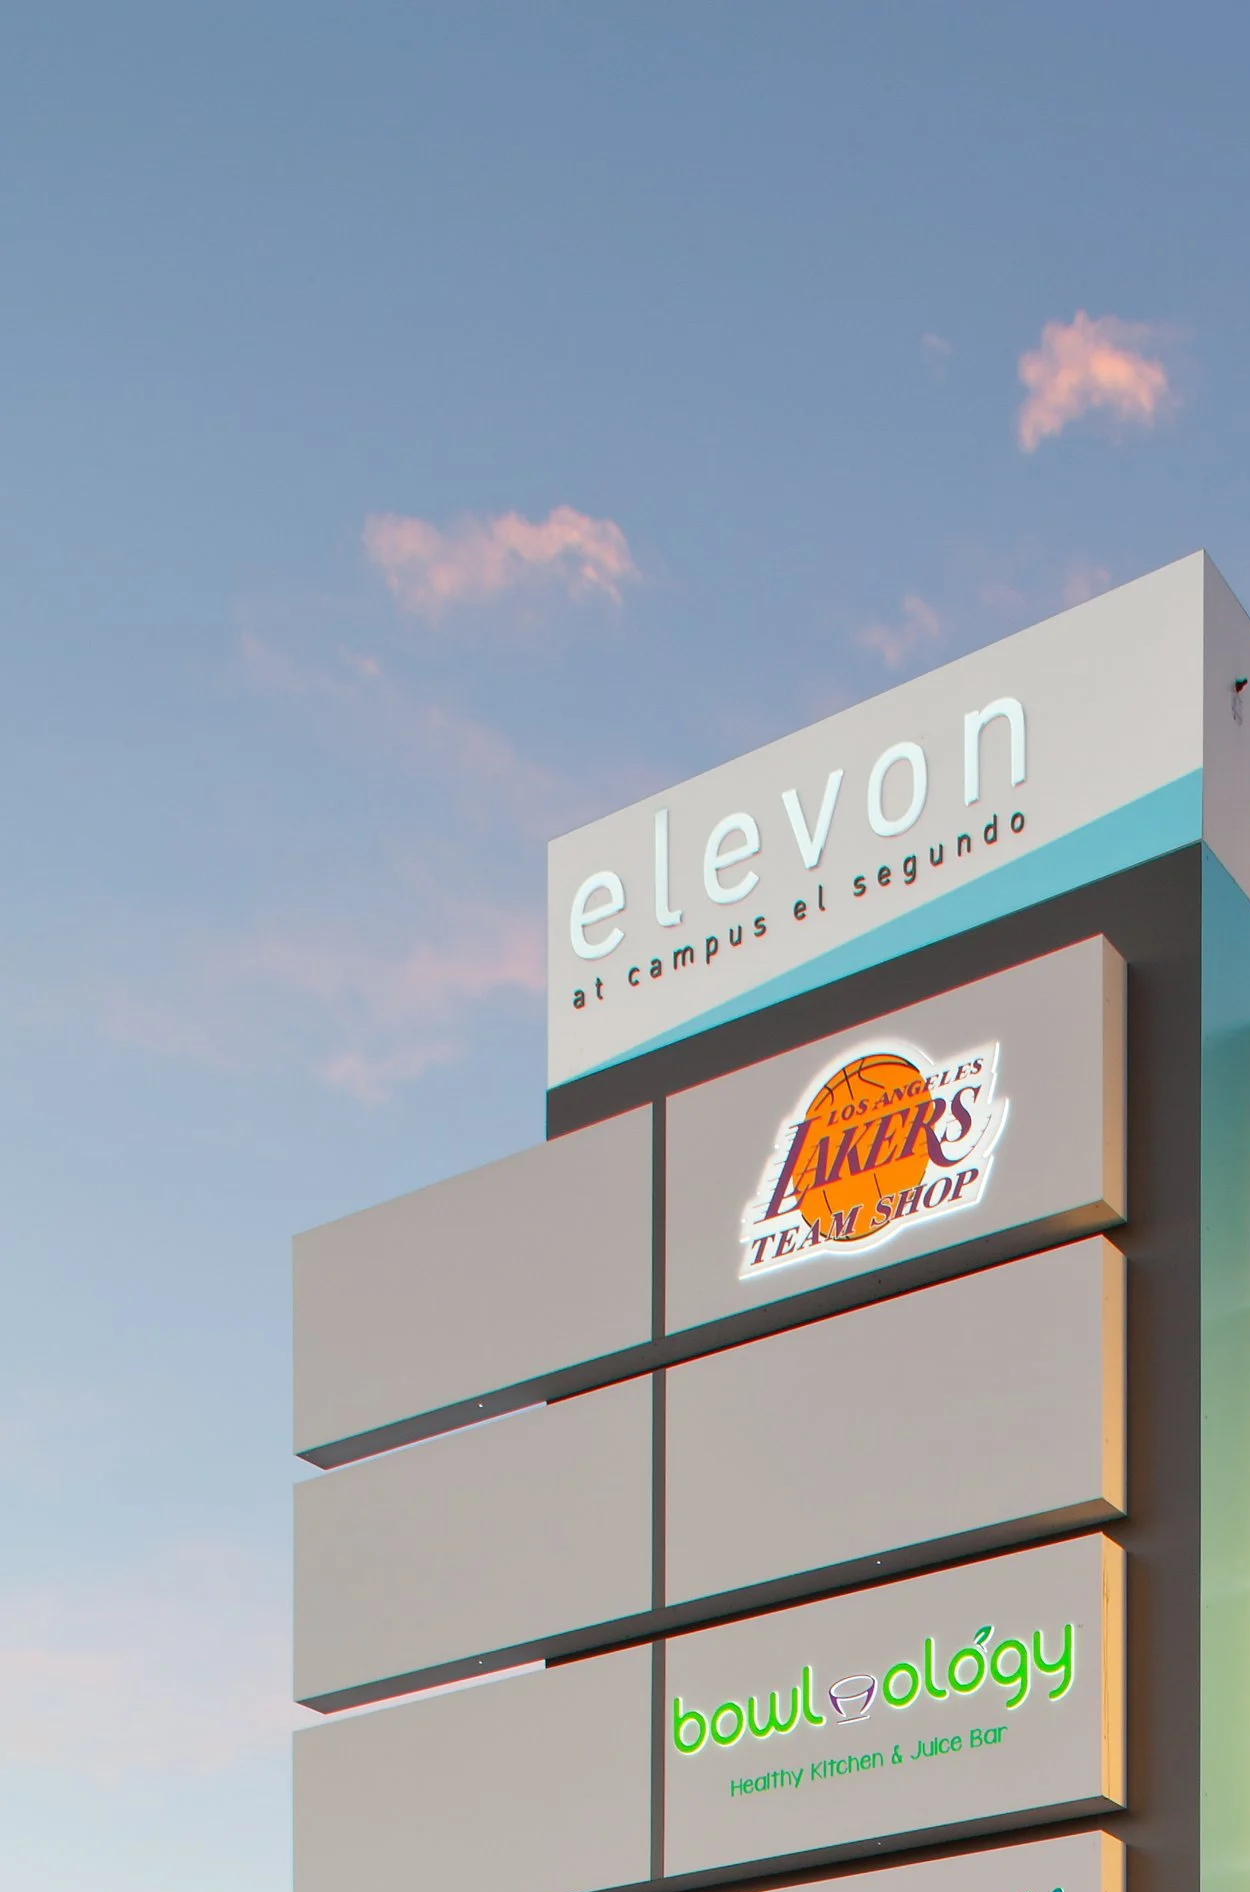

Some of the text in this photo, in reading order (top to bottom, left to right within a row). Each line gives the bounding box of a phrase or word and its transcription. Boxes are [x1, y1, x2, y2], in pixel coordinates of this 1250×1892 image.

[570, 697, 1027, 960] elevon
[573, 810, 1026, 1010] at campus el segundo
[827, 1058, 984, 1126] LOS ANGELES
[754, 1085, 991, 1224] LAKERS
[750, 1168, 979, 1266] TEAM SHOP
[731, 1724, 1008, 1797] Healthy Kitchen & Juice Bar
